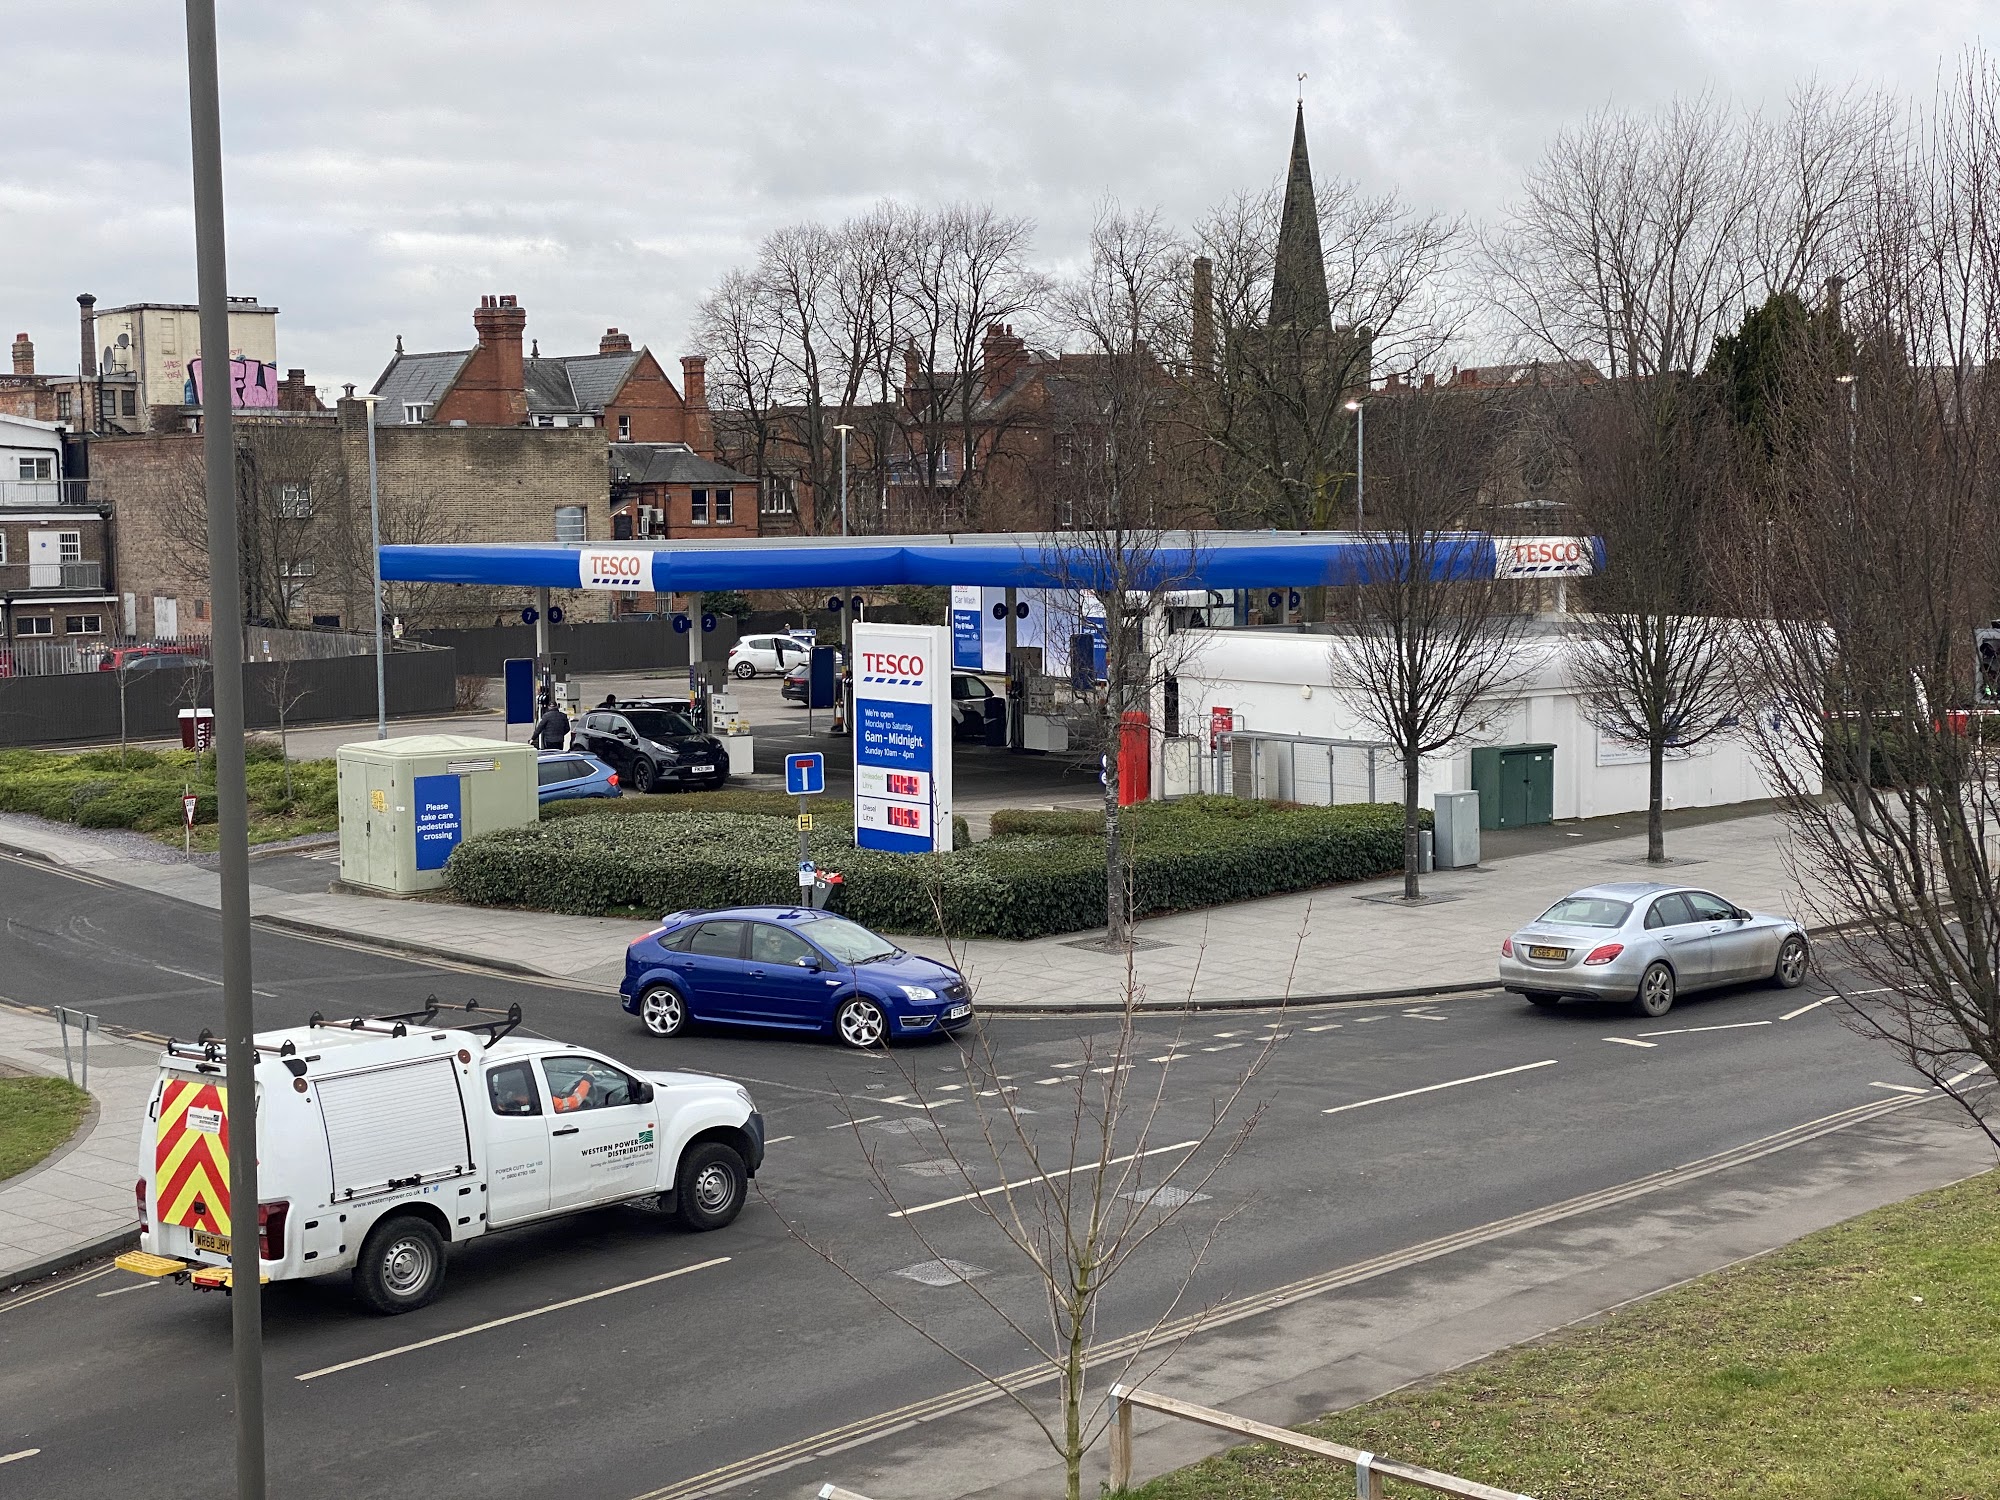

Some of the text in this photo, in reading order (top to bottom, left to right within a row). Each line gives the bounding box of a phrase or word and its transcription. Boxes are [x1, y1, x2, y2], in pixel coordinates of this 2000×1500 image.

[1511, 543, 1580, 563] TESCO
[591, 556, 640, 576] TESCO
[832, 600, 837, 608] 9
[1271, 596, 1277, 605] 5
[1291, 595, 1297, 604] 6
[526, 611, 532, 620] 7
[552, 610, 558, 619] 8
[997, 607, 1002, 616] 3
[1019, 607, 1025, 615] 4
[679, 620, 683, 629] 1
[706, 619, 712, 628] 2
[862, 653, 924, 676] TESCO
[865, 708, 894, 720] We're open
[865, 719, 913, 733] Monday to Saturday
[865, 730, 883, 743] 6am
[889, 733, 923, 749] Midnight
[865, 746, 883, 757] Sunday
[884, 748, 898, 757] 10am
[902, 750, 915, 760] 4pm
[862, 772, 883, 781] Unleaded
[862, 782, 873, 790] Litre
[425, 803, 449, 811] Please
[862, 804, 876, 813] Diesel
[421, 812, 454, 821] take care
[862, 814, 874, 822] Litre
[892, 807, 920, 828] 146.9
[416, 821, 459, 833] pedestrians
[801, 816, 810, 829] H
[423, 831, 453, 840] crossing
[581, 1138, 639, 1157] WESTERN POWER
[608, 1142, 654, 1158] DISTRIBUTION
[352, 1189, 420, 1209] www.westernpower.co.uk
[197, 1235, 230, 1252] WR68 JHY
